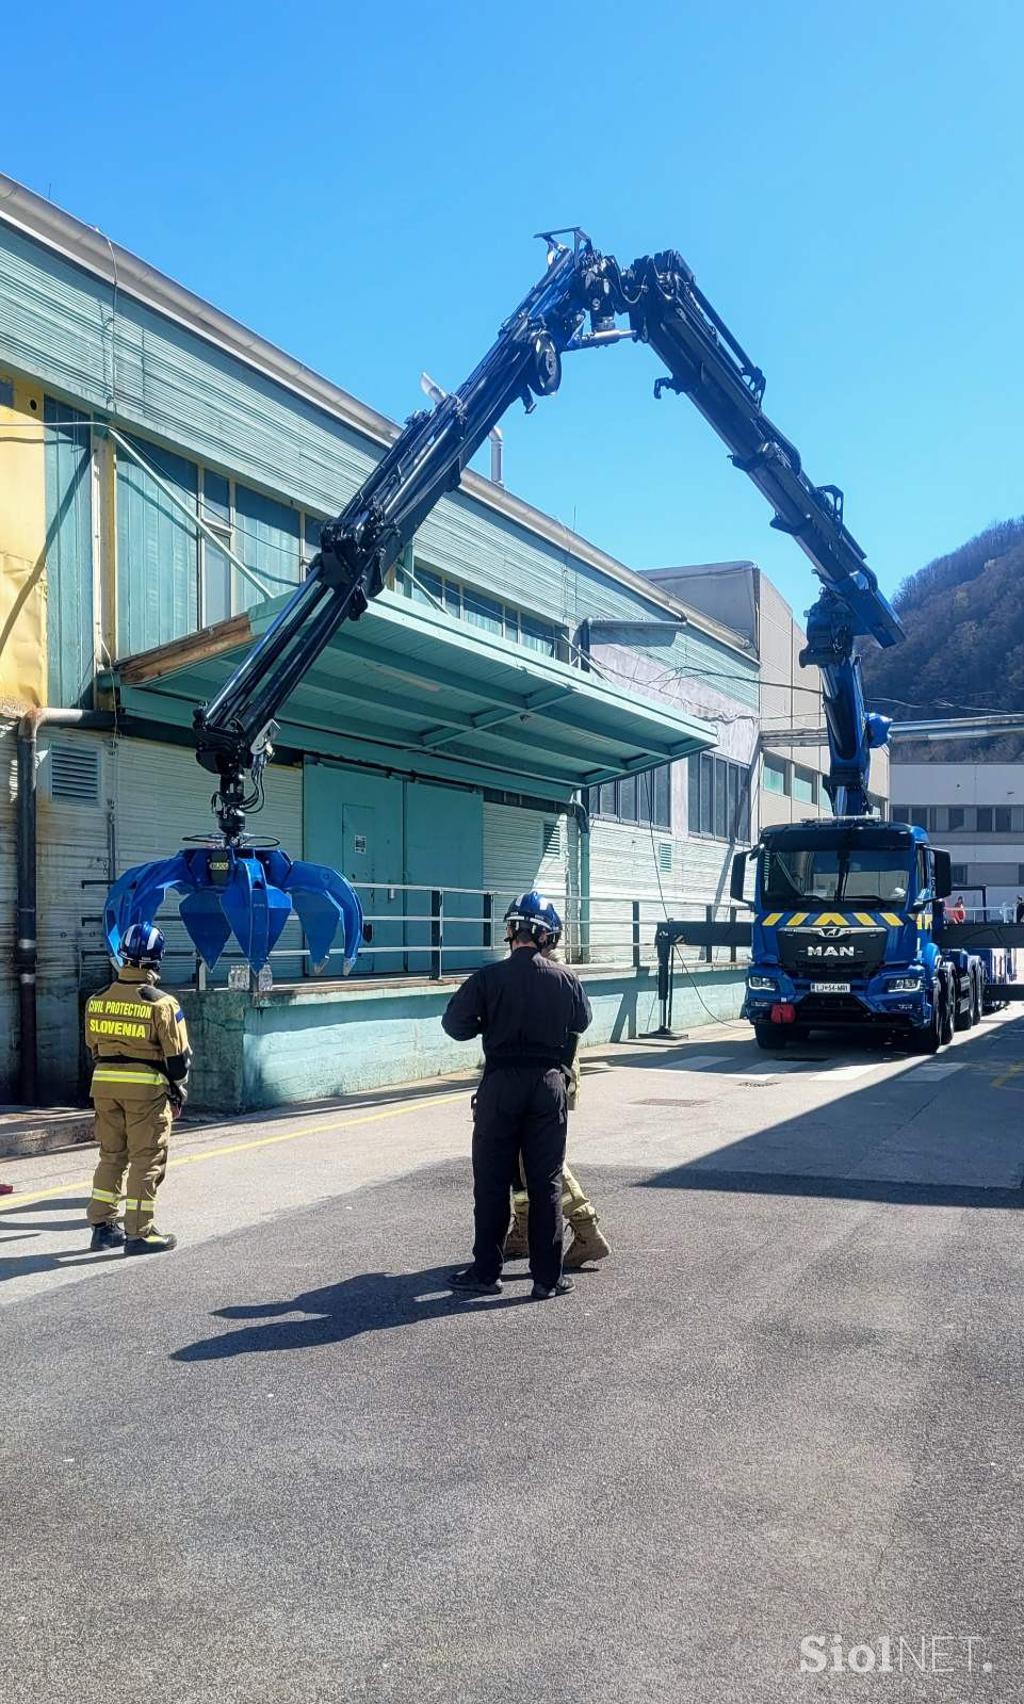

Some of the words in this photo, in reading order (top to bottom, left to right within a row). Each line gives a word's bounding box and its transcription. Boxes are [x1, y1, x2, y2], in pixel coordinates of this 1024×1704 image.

[807, 946, 855, 956] MAN
[88, 1000, 104, 1013] CIVIL
[105, 1001, 152, 1019] PROTECTION
[89, 1019, 146, 1039] SLOVENIA
